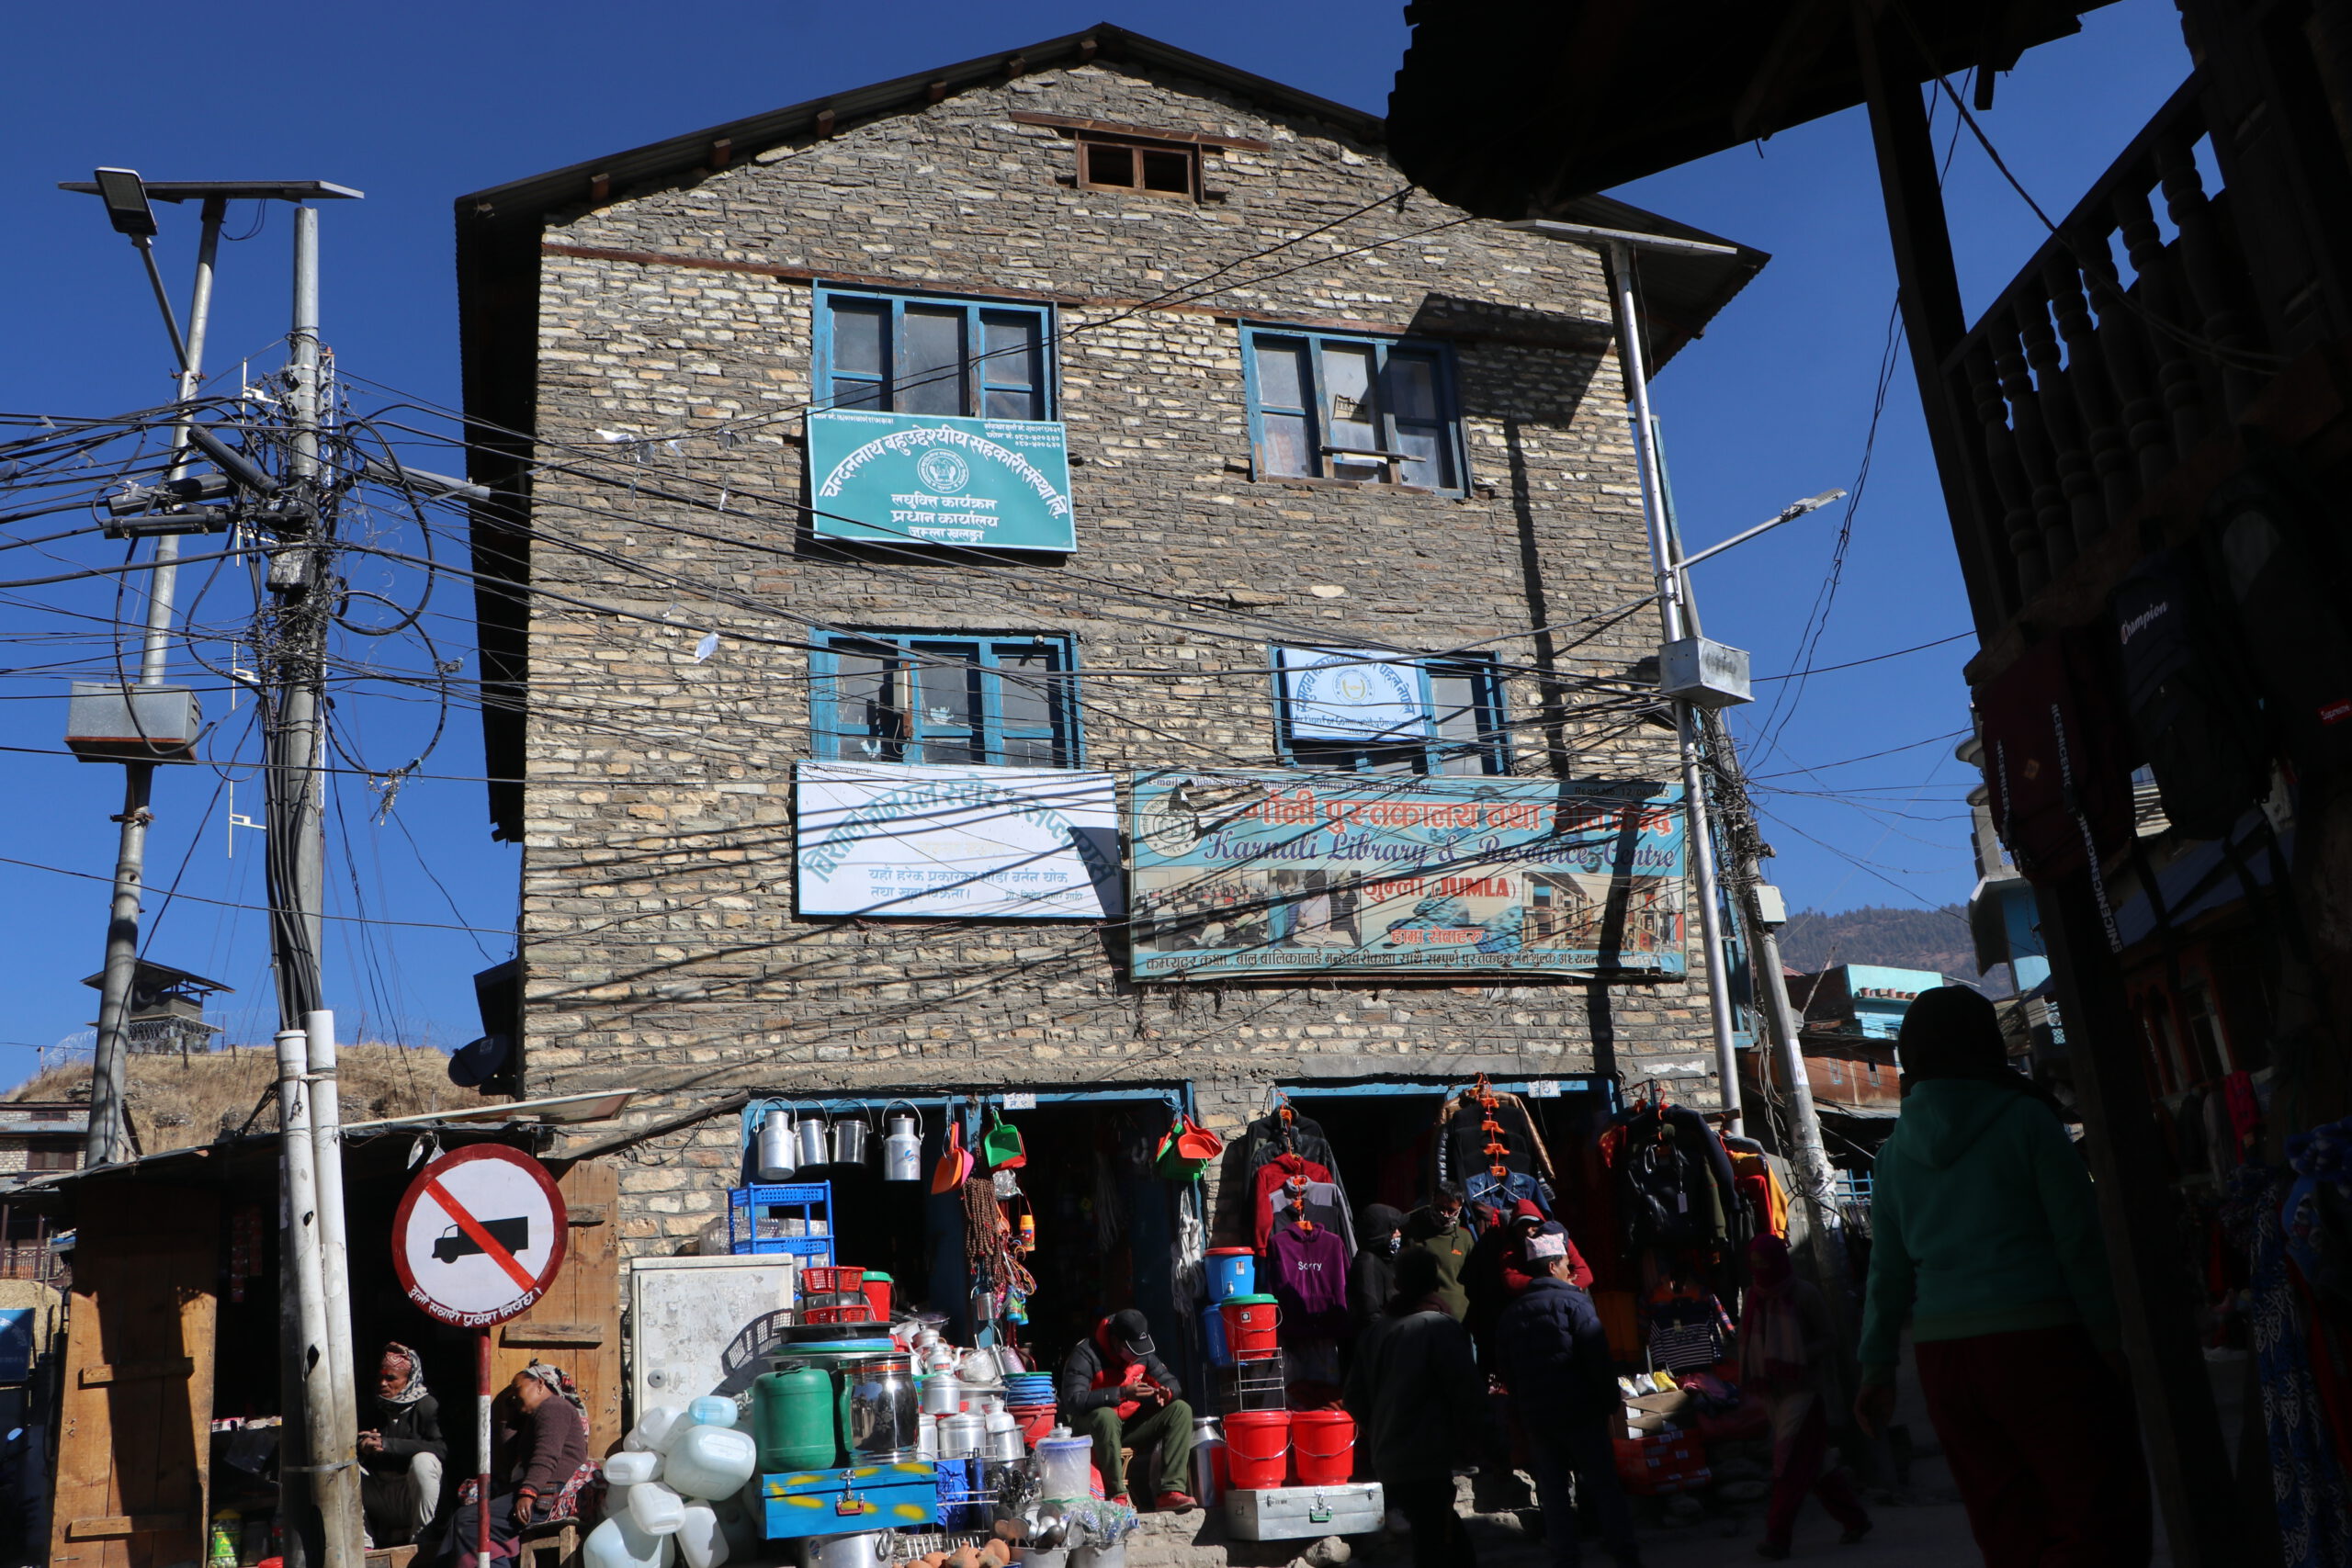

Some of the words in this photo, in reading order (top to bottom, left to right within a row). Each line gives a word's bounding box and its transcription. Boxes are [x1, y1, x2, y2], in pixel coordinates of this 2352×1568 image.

[819, 439, 887, 497] चन्दननाथ
[970, 434, 1028, 474] सहकारी
[1022, 466, 1057, 500] संस्था
[940, 494, 998, 511] कार्यक्रम
[890, 510, 936, 524] प्रधान
[938, 510, 1000, 529] कार्यालय
[2120, 601, 2168, 645] Champion
[2320, 704, 2351, 721] Supreme
[1324, 799, 1482, 835] पुस्तकालय
[1485, 802, 1541, 830] तथा
[1204, 830, 1318, 860] Karnali
[1327, 831, 1430, 870] Library
[1604, 842, 1676, 867] Centre
[897, 866, 924, 883] हरेक
[871, 886, 896, 898] तथा
[1431, 877, 1517, 901] (JUMLA)
[1260, 949, 1322, 964] बालिकालाई
[1297, 1260, 1322, 1271] Sorry
[428, 1301, 461, 1323] सवारी
